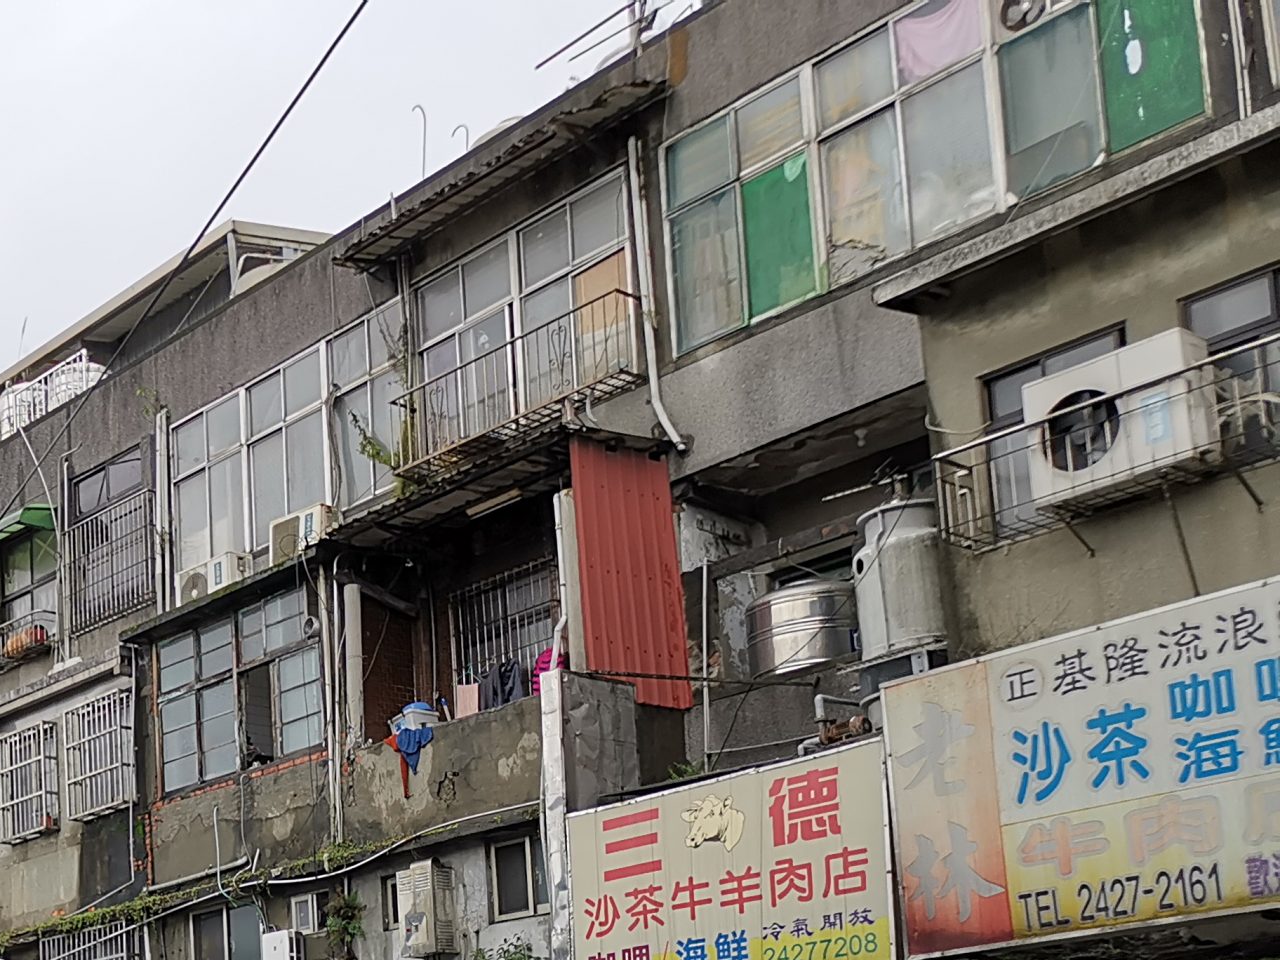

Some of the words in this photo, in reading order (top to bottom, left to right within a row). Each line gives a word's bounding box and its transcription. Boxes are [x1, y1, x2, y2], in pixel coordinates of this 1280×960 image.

[1053, 602, 1280, 695] 基隆流浪
[1012, 708, 1150, 805] 沙茶
[584, 847, 869, 940] 沙茶牛羊肉店
[763, 908, 875, 942] 冷氣開放
[1017, 889, 1070, 931] TEL
[1078, 862, 1223, 922] 2427-2161
